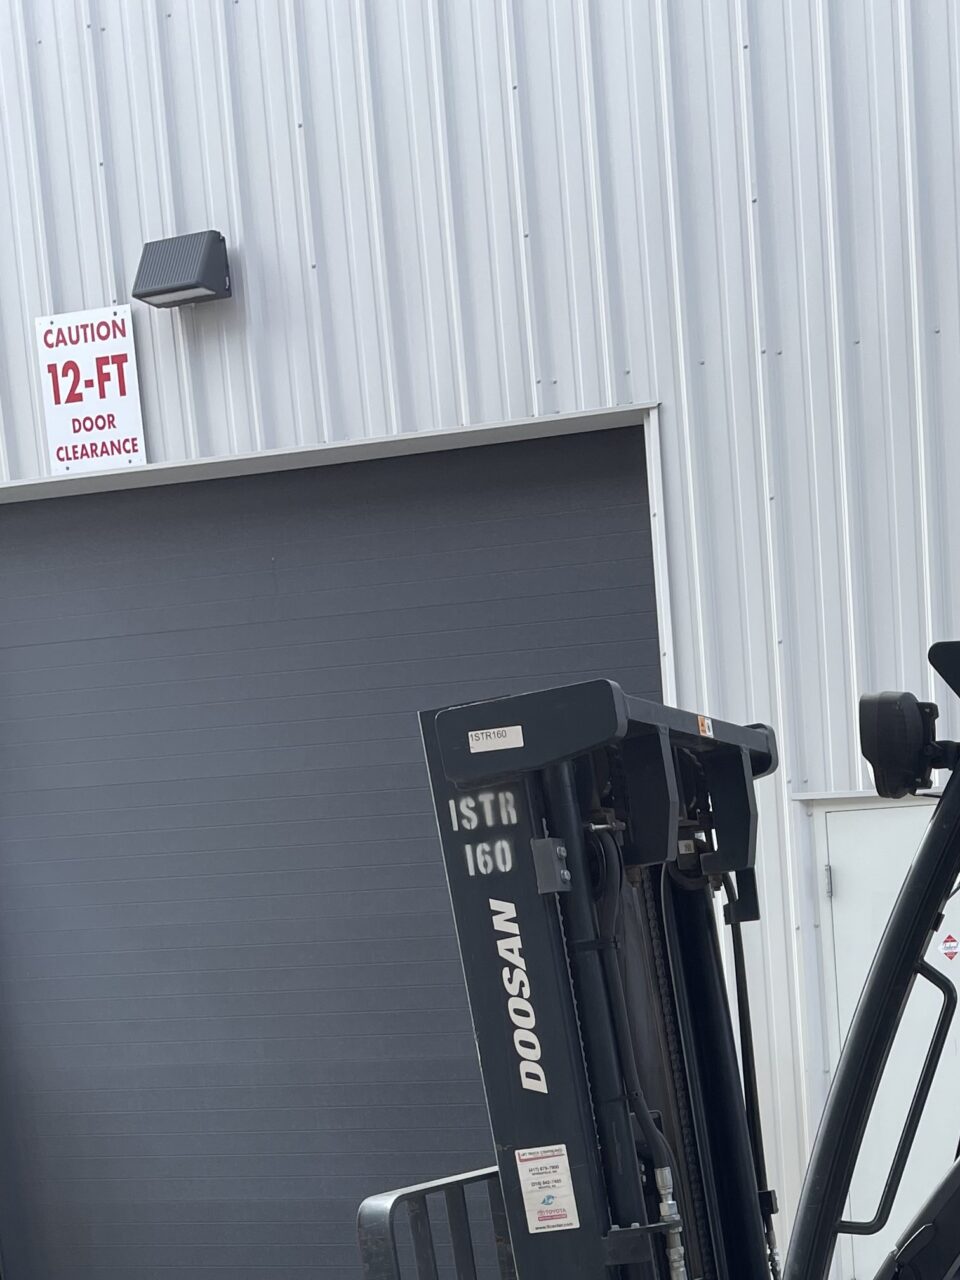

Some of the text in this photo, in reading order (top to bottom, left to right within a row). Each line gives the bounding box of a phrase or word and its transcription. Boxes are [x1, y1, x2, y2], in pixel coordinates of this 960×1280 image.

[43, 318, 126, 349] CAUTION
[47, 353, 128, 406] 12-FT
[72, 414, 116, 433] DOOR
[56, 437, 139, 462] CLEARANCE
[470, 729, 507, 742] 1STR160
[465, 839, 513, 877] 160
[489, 898, 548, 1094] DOOSAN
